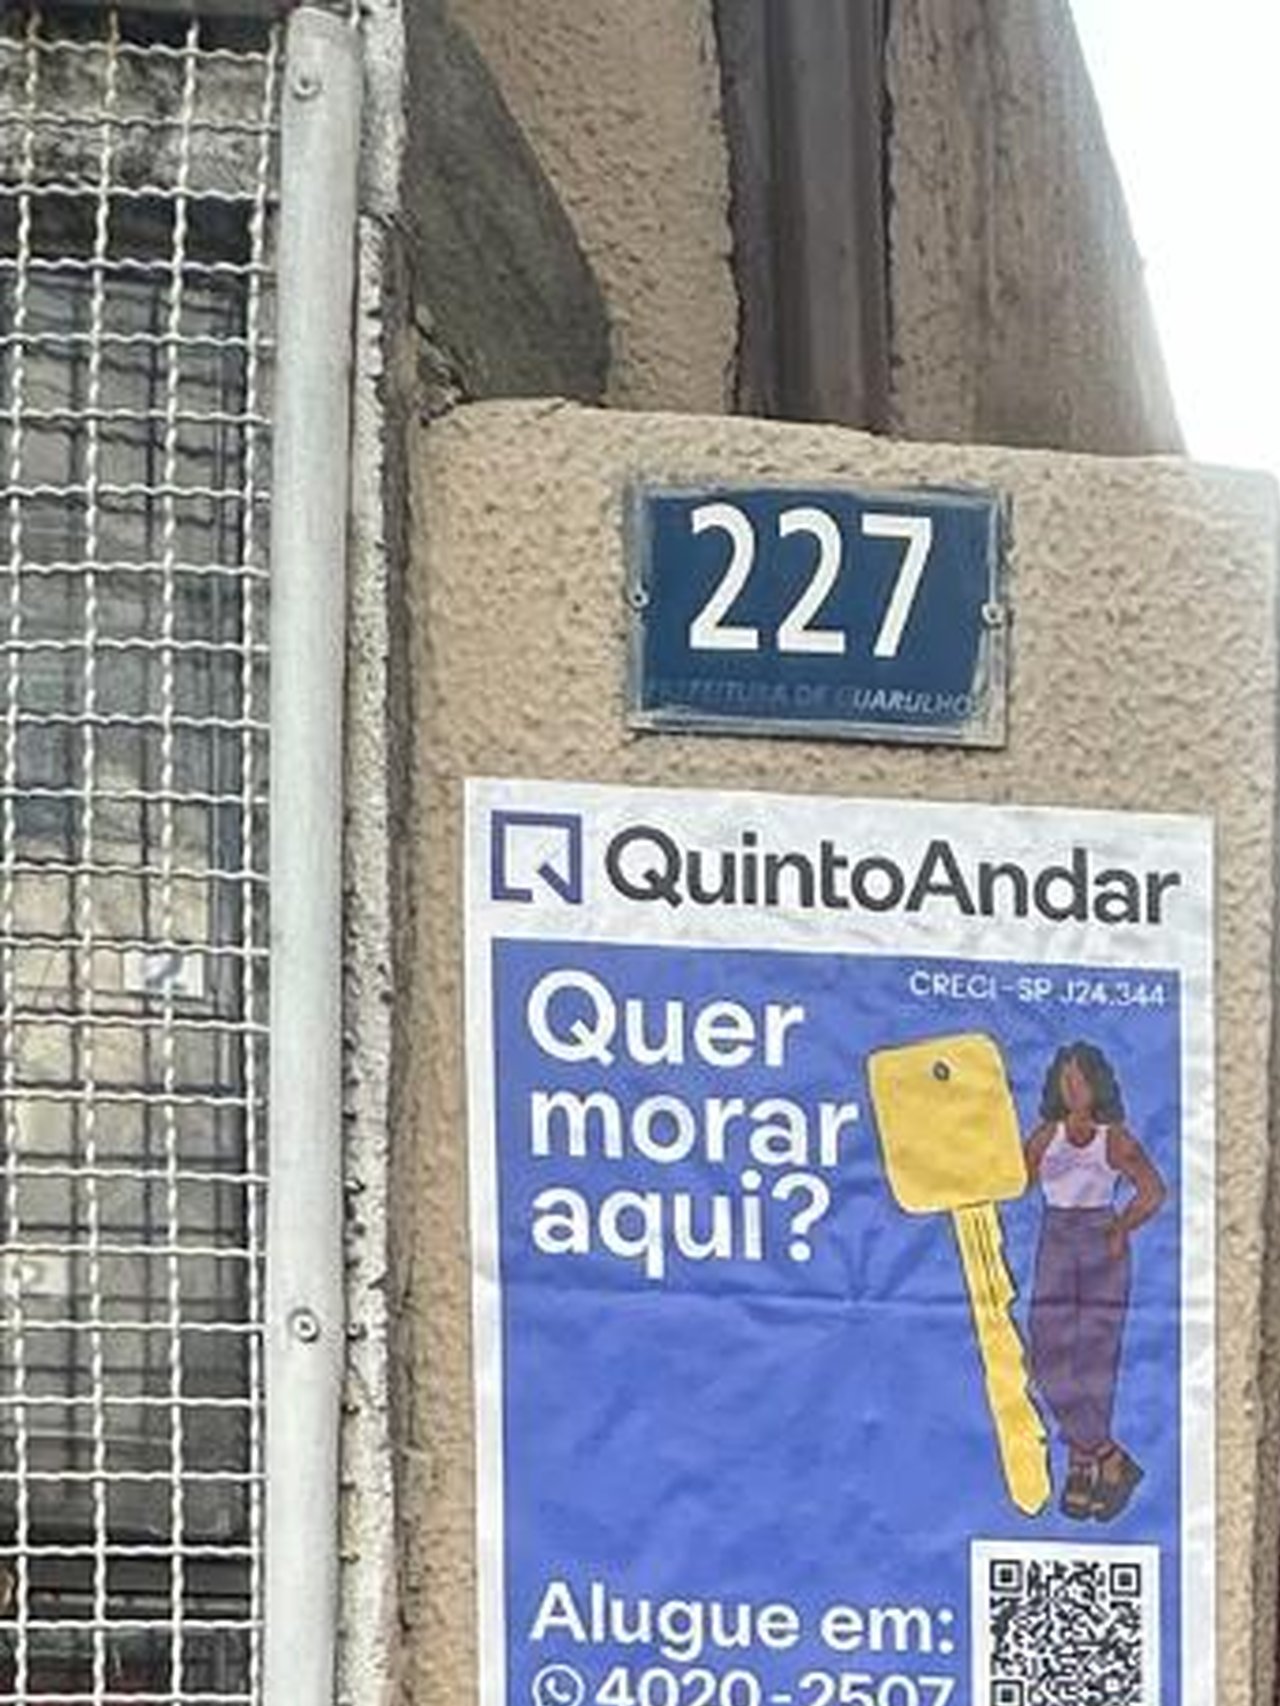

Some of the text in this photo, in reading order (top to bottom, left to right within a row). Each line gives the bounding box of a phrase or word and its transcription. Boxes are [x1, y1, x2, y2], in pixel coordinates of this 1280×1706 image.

[690, 503, 933, 658] 227
[646, 677, 793, 710] FEITURA
[604, 825, 1182, 926] QuintoAndar
[527, 969, 806, 1068] Quer
[530, 1090, 859, 1167] morar
[531, 1169, 831, 1279] aqui?
[530, 1581, 955, 1663] Alugue em:
